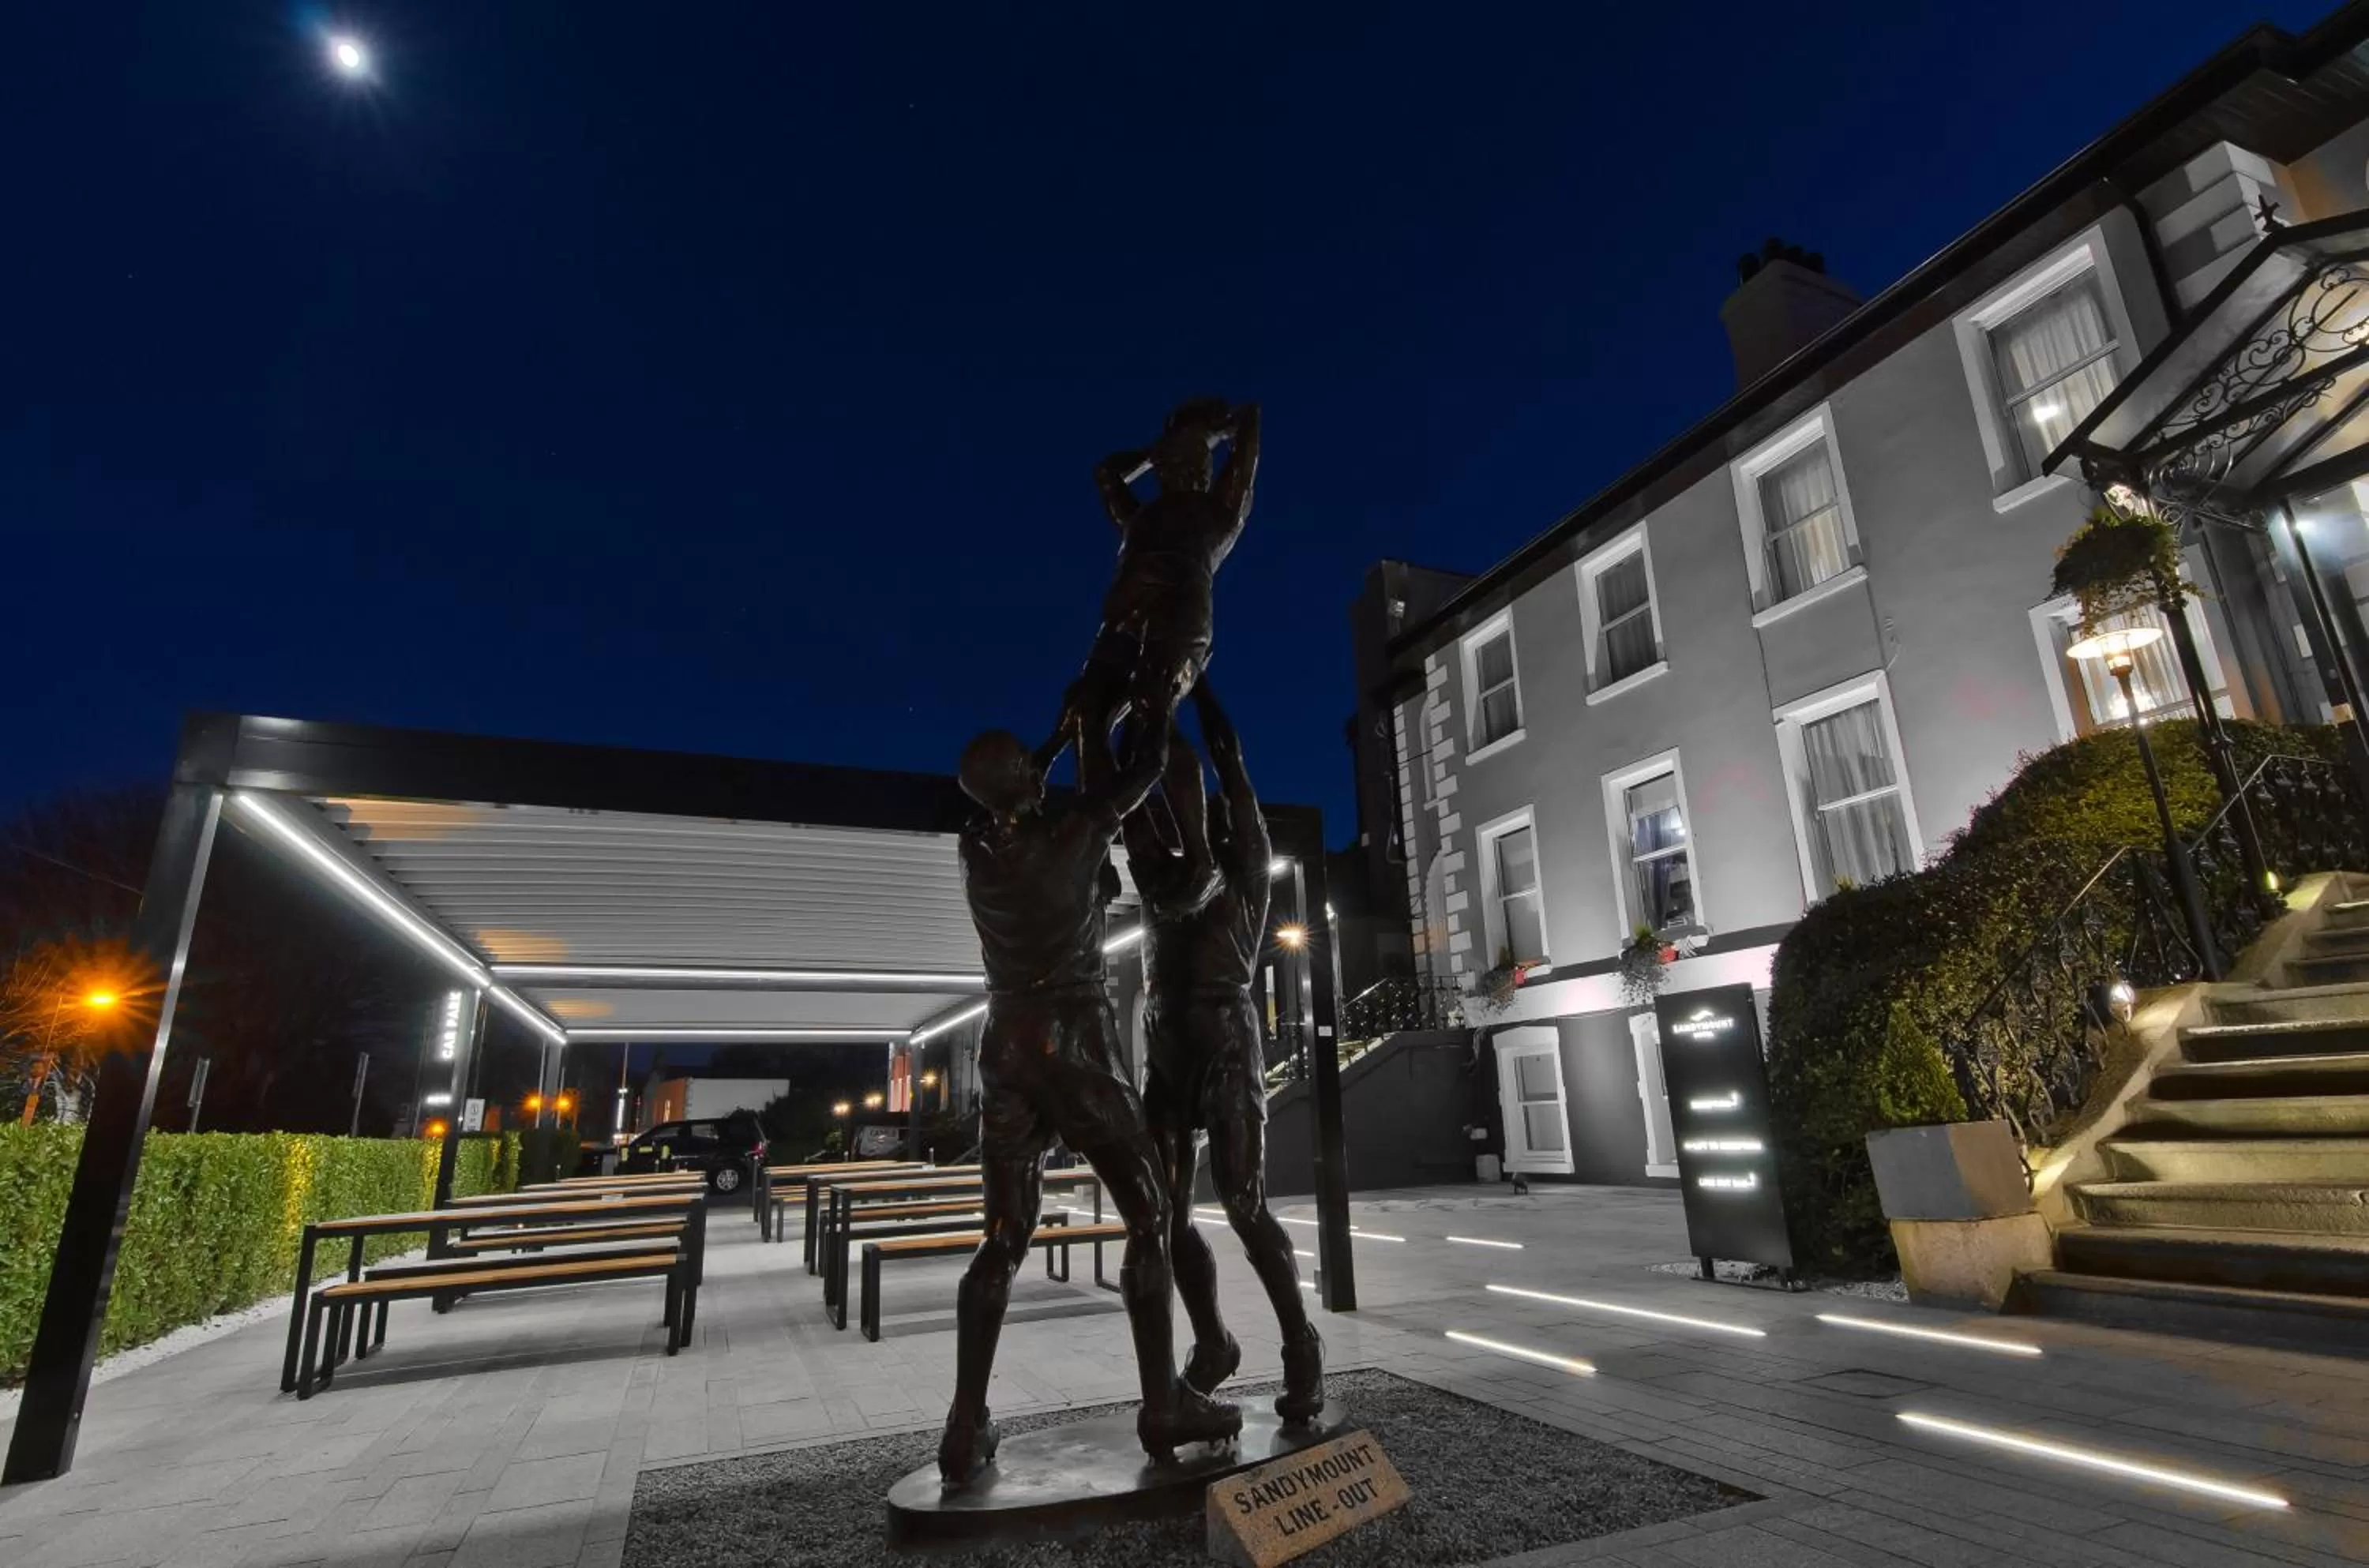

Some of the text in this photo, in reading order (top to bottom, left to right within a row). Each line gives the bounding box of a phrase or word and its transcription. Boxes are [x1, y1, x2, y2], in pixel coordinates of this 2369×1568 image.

[441, 992, 461, 1060] CAR PARK
[1233, 1444, 1375, 1514] SANDYMOUNT
